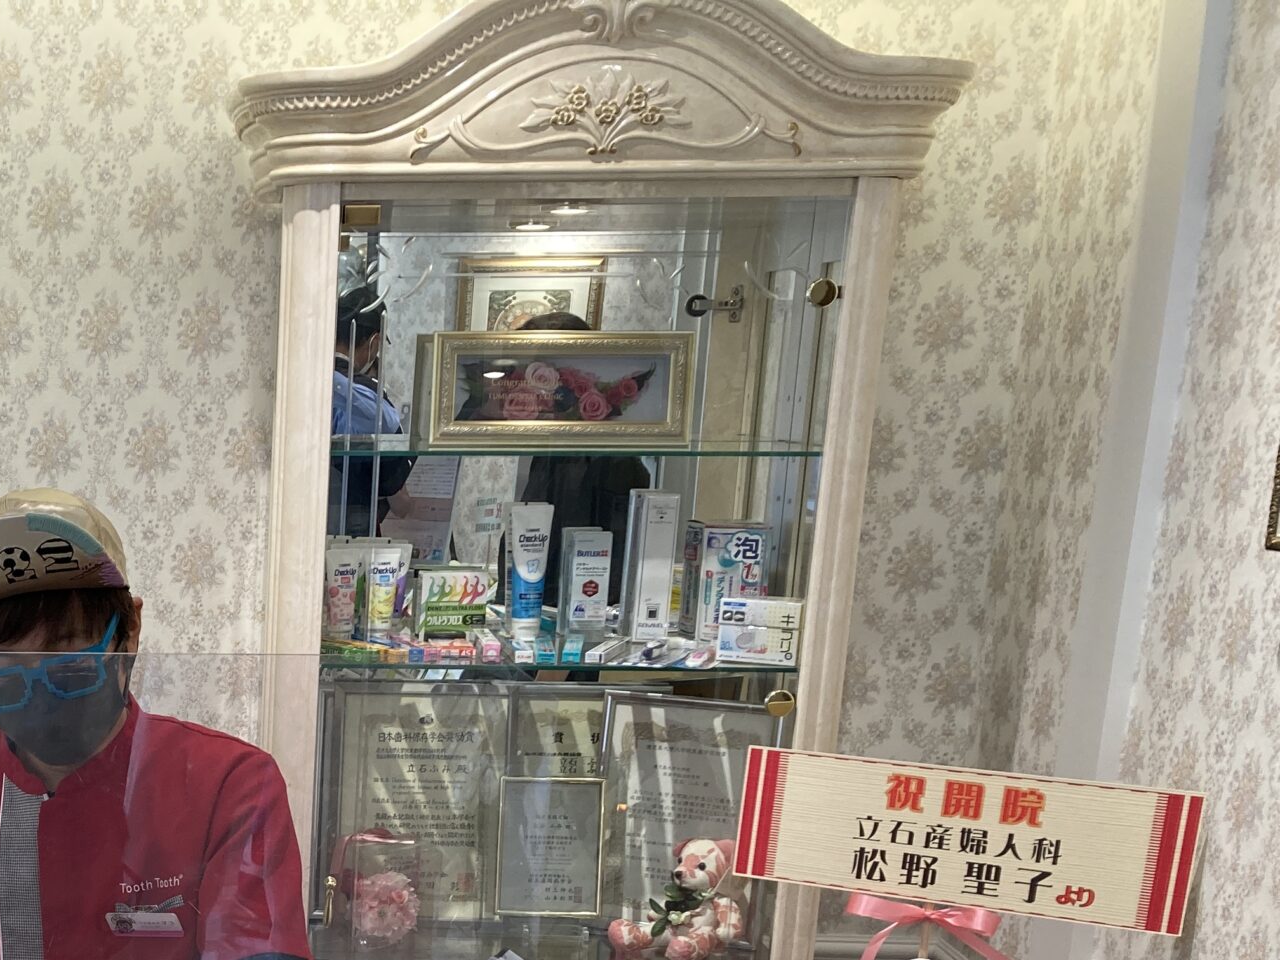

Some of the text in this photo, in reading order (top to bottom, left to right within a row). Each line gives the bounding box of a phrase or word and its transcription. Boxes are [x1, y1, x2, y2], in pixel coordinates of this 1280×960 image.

[733, 536, 760, 560] 泡
[885, 773, 1047, 828] 祝開院
[852, 816, 1063, 866] 立石産婦人科
[119, 876, 180, 894] Tooth Tooth
